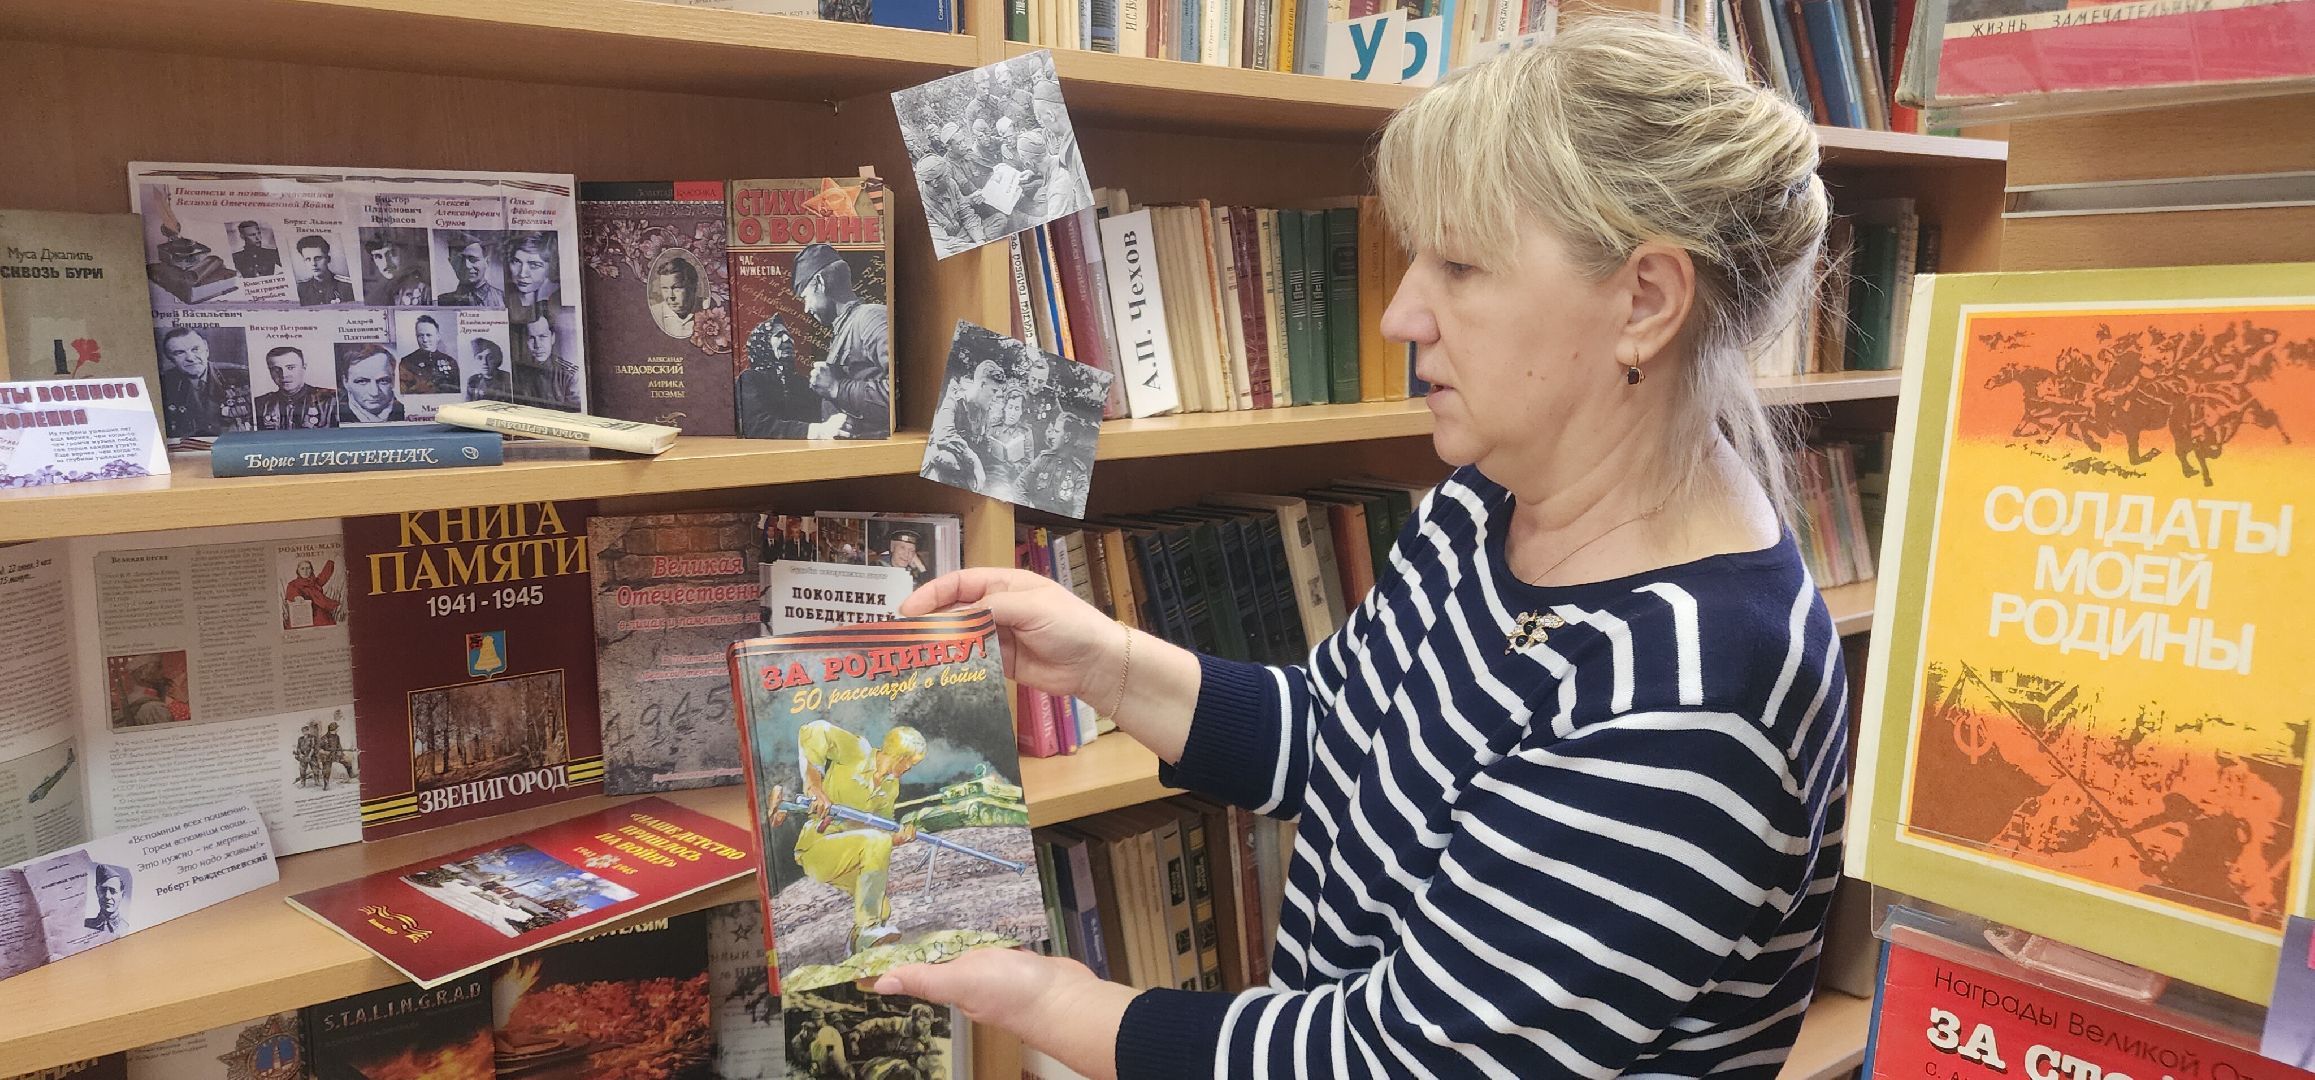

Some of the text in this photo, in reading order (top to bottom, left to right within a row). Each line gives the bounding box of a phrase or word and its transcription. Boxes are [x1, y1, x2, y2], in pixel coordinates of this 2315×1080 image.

[1971, 19, 2027, 38] ЖИЗНЬ
[175, 187, 227, 196] Писатели
[176, 198, 335, 209] Великой Отечественной Войны
[737, 210, 881, 244] О ВОЙНЕ
[7, 246, 93, 263] Муса Джалиль
[739, 255, 754, 265] ЧАС
[0, 265, 103, 279] СКВОЗЬ БУРИ
[739, 265, 782, 277] МУЖЕСТВА
[1012, 253, 1027, 296] ГОЛУБОЙ
[182, 310, 243, 319] Васильевич
[1124, 230, 1163, 393] А.П. Чехов
[36, 383, 140, 402] ВОЕННОГО
[648, 380, 685, 389] ЛИРИКА
[650, 389, 685, 399] ПОЭМЫ
[245, 447, 439, 471] Борис ПАСТЕРНАК
[397, 501, 568, 548] КНИГА
[1984, 484, 2294, 557] СОЛДАТЫ
[366, 536, 590, 596] ПАМЯТИ
[653, 555, 744, 578] Великая
[2033, 545, 2213, 610] МОЕЙ
[792, 586, 887, 606] ПОКОЛЕНИЯ
[1988, 592, 2256, 675] РОДИНЫ
[760, 636, 988, 691] ЗА РОДИНУ!
[790, 666, 988, 714] 50 рассказов о войне
[419, 764, 570, 814] ЗВЕНИГОРОД
[183, 819, 202, 830] всех
[142, 828, 219, 856] Горем вспомним
[594, 833, 677, 868] НА ВОЙНУ»
[618, 825, 704, 861] ПРИШЛОСЬ
[670, 831, 746, 860] ДЕТСТВО
[137, 861, 159, 873] Это
[161, 850, 194, 865] нужно
[203, 842, 214, 852] не
[177, 863, 198, 875] Это
[200, 853, 223, 867] надо
[156, 852, 268, 896] Роберт Рождественский
[1935, 967, 2200, 1078] Награды Великой
[1926, 1007, 2007, 1072] ЗА
